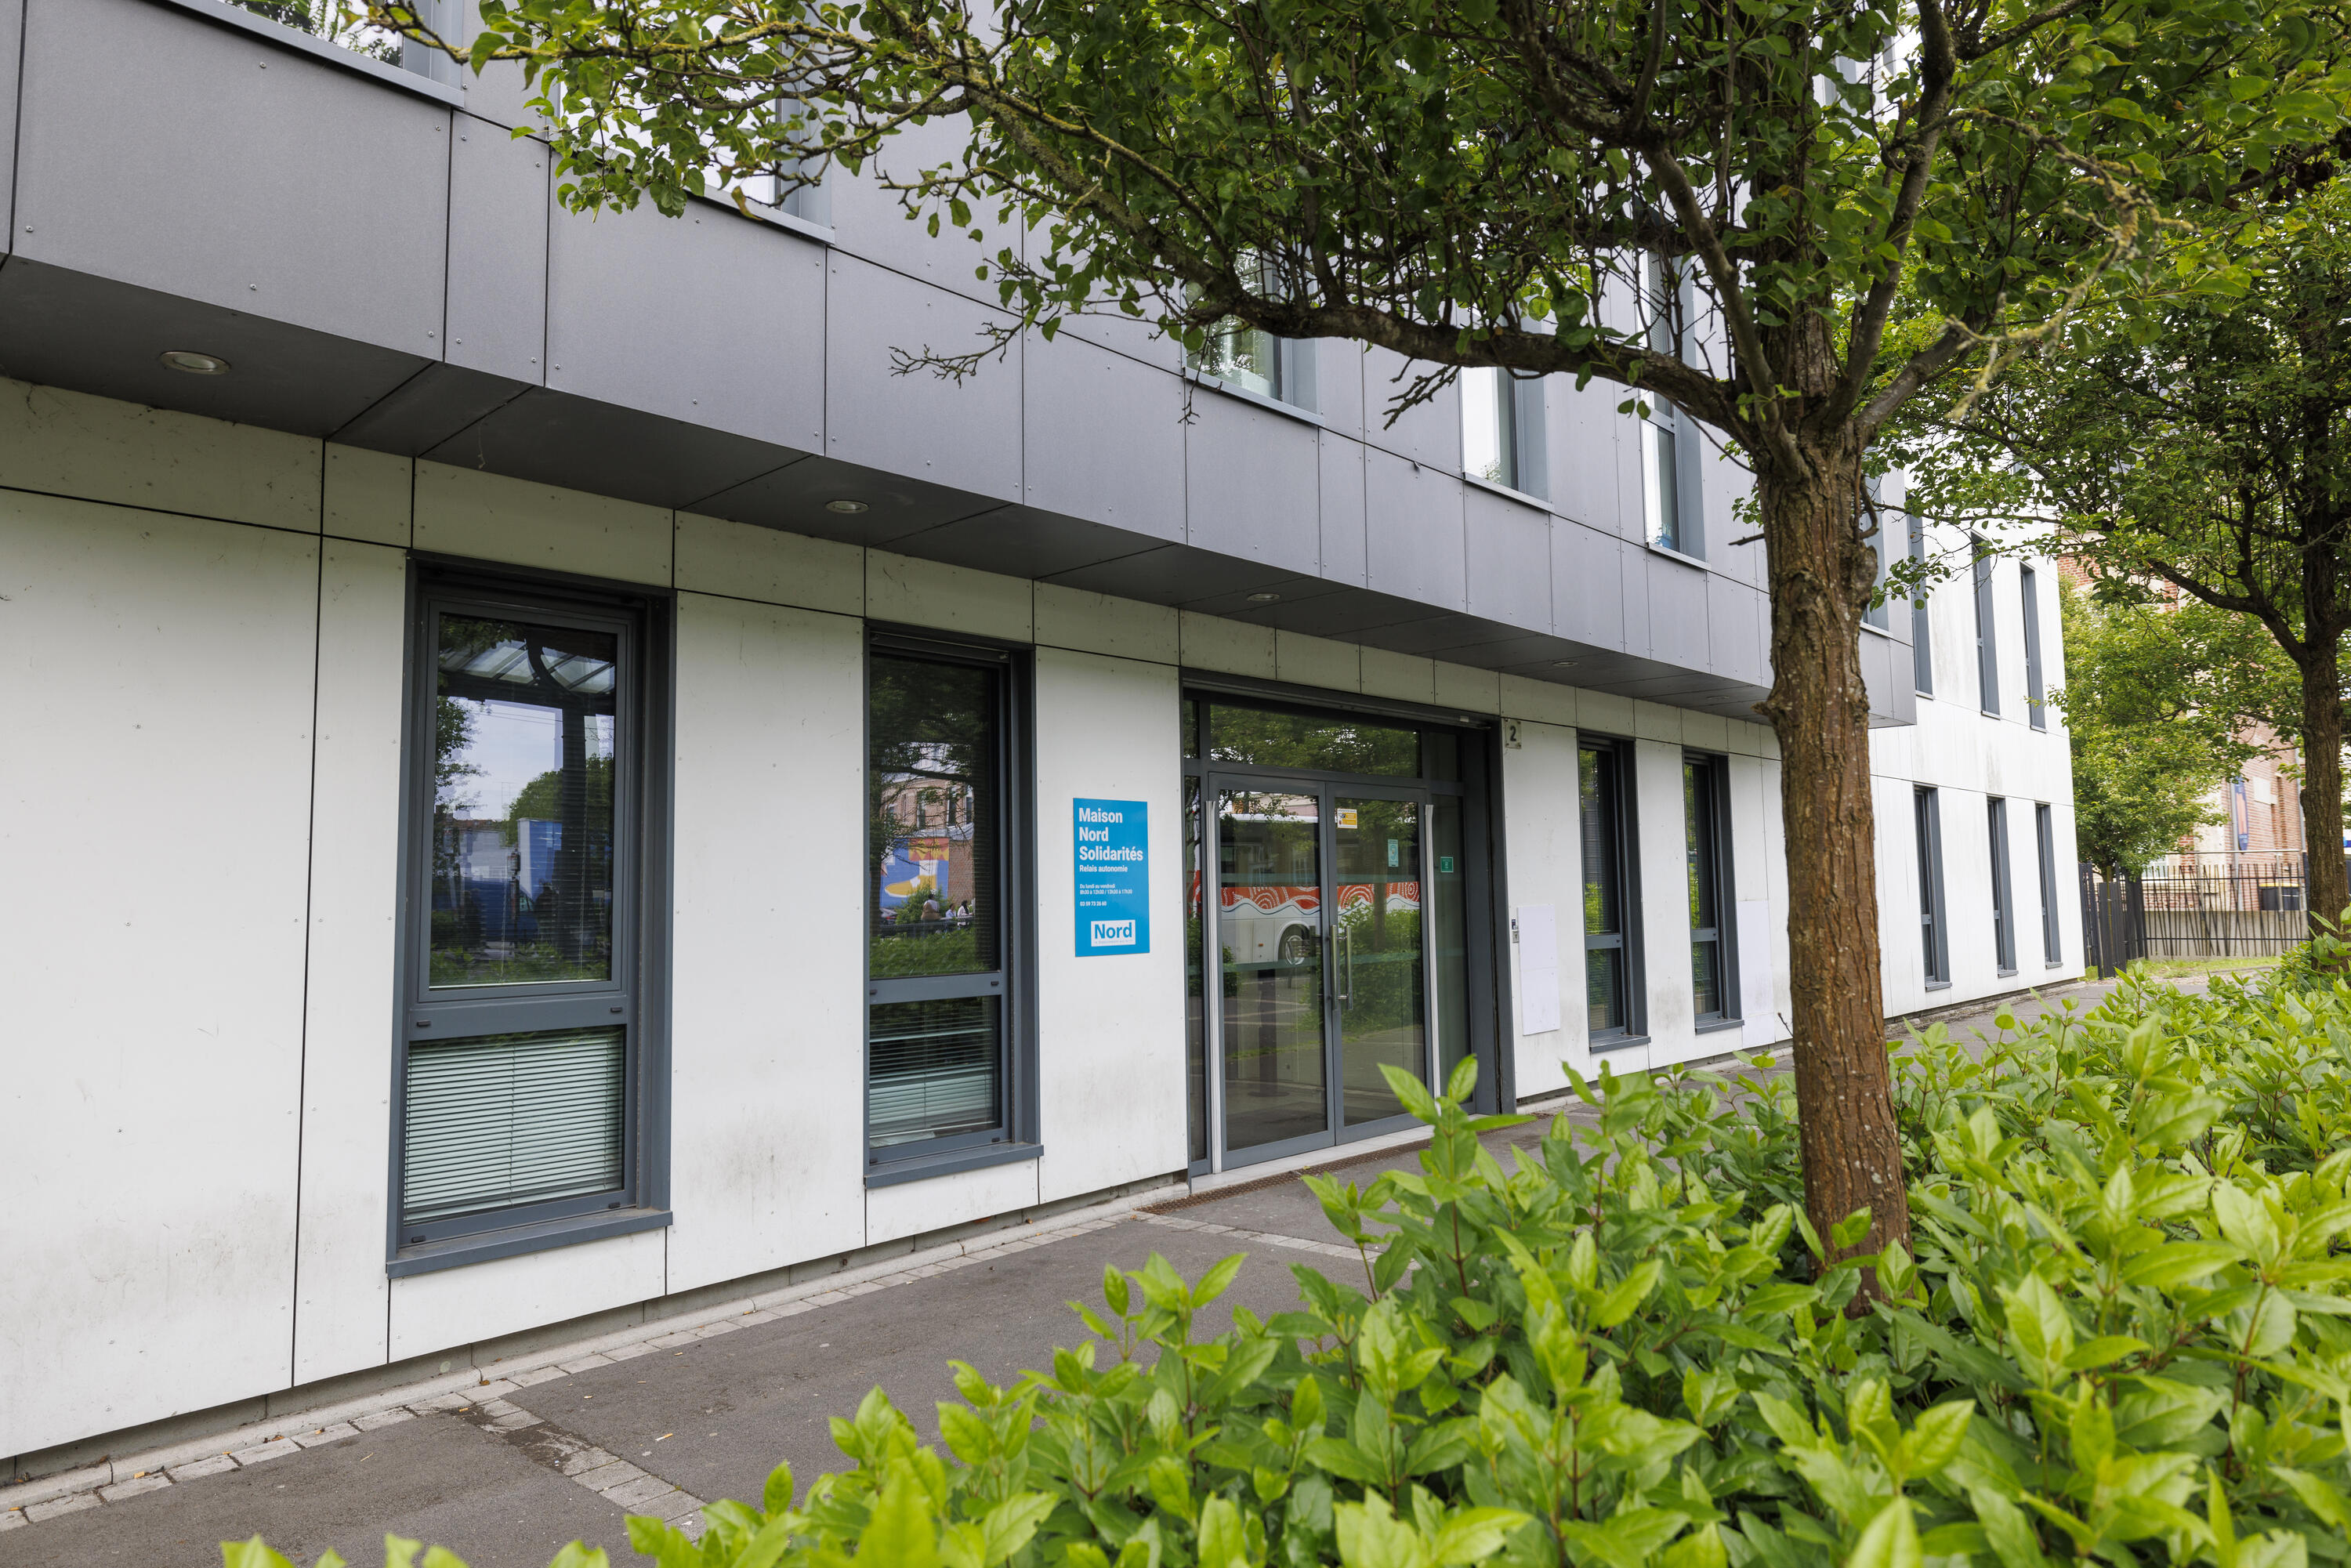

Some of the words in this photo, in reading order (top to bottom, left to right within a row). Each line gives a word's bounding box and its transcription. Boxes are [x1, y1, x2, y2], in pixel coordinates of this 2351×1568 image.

[1510, 726, 1516, 741] 2
[1079, 808, 1123, 823] Maison
[1079, 827, 1109, 842] Nord
[1079, 846, 1143, 861] Solidarités
[1095, 922, 1132, 939] Nord
